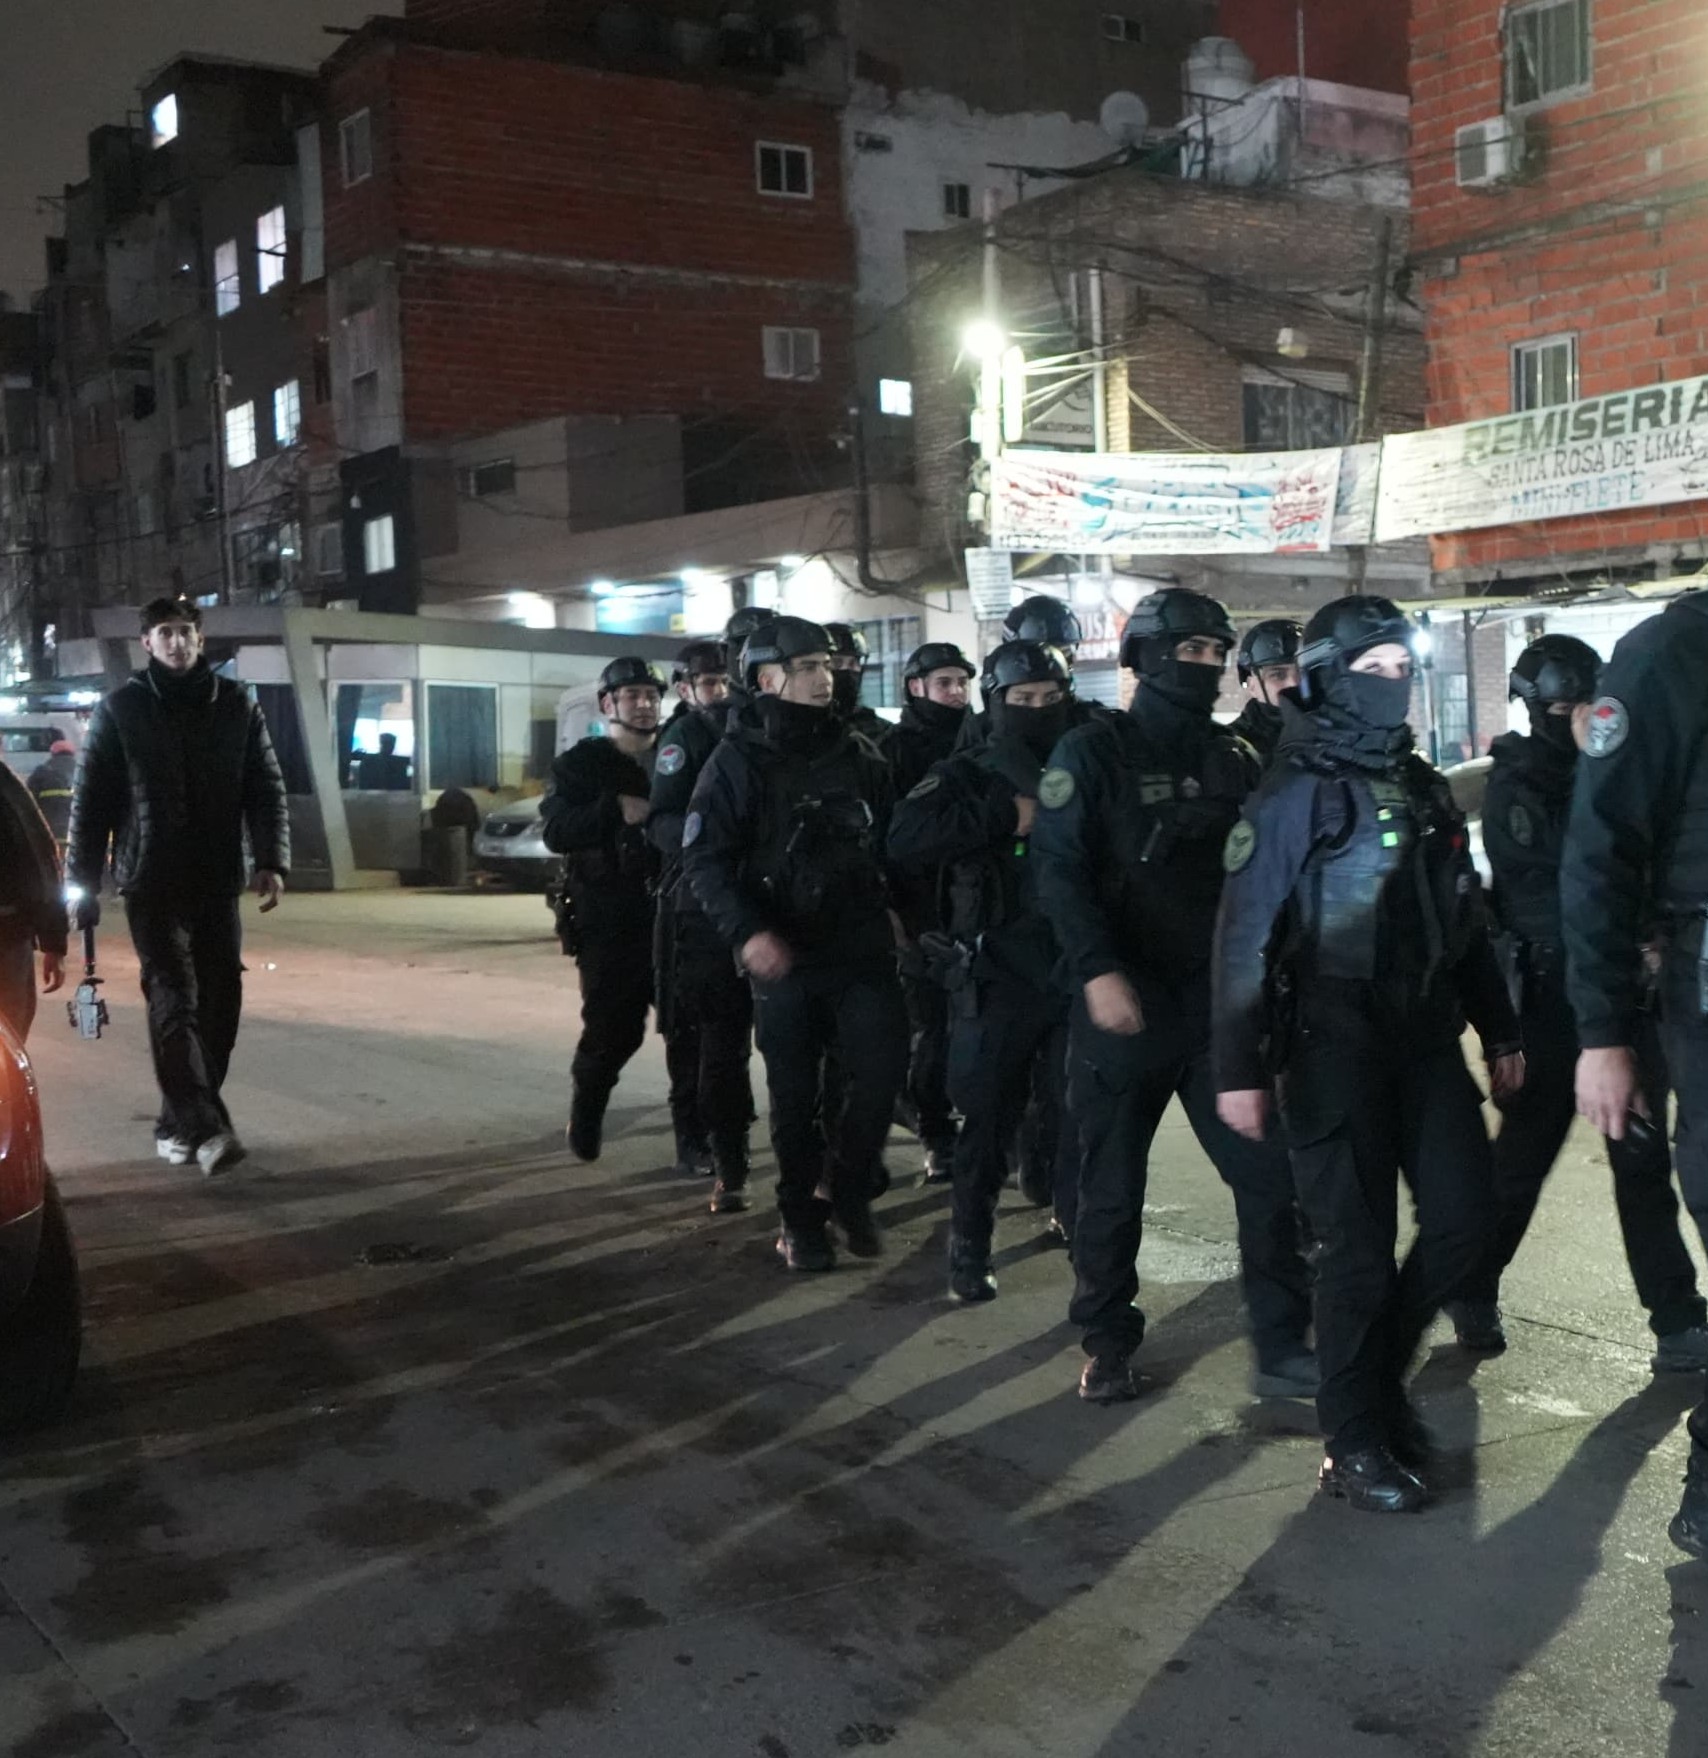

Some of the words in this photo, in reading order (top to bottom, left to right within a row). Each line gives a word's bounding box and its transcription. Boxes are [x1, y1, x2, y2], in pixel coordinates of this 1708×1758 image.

[1488, 453, 1547, 488] SANTA
[1553, 443, 1606, 479] ROSA
[1612, 439, 1638, 469] DE
[1644, 429, 1695, 463] LIMA
